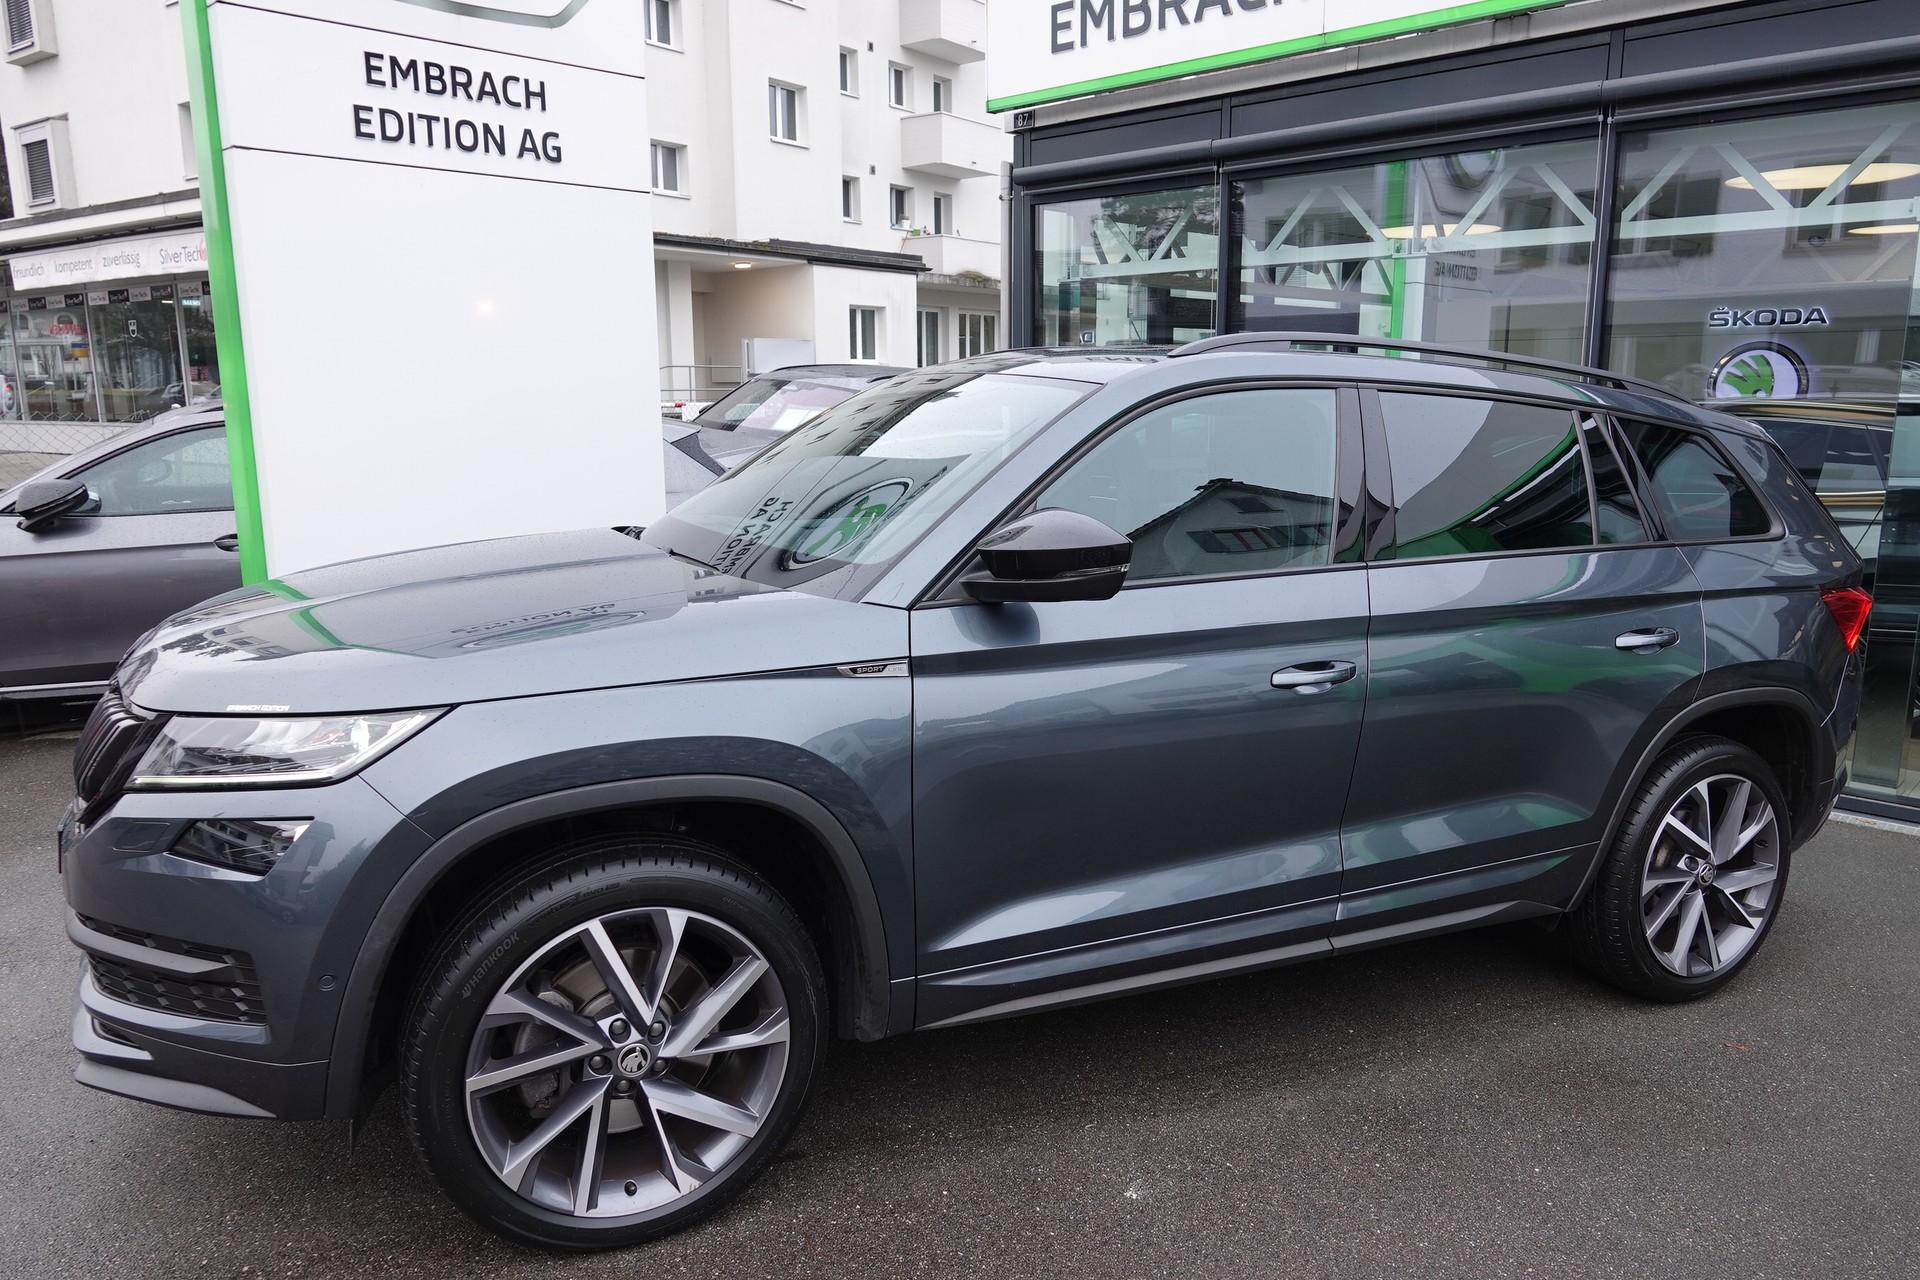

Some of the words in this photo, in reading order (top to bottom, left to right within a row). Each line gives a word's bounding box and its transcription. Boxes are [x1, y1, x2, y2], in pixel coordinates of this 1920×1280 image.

[1050, 0, 1286, 54] EMBR
[364, 51, 547, 112] EMBRACH
[1017, 113, 1029, 127] 87
[353, 104, 506, 157] EDITION
[517, 128, 562, 163] AG
[13, 263, 45, 279] freundlich
[54, 259, 93, 276] kompetent
[1708, 307, 1828, 328] ŠKODA
[857, 665, 884, 673] SPORT
